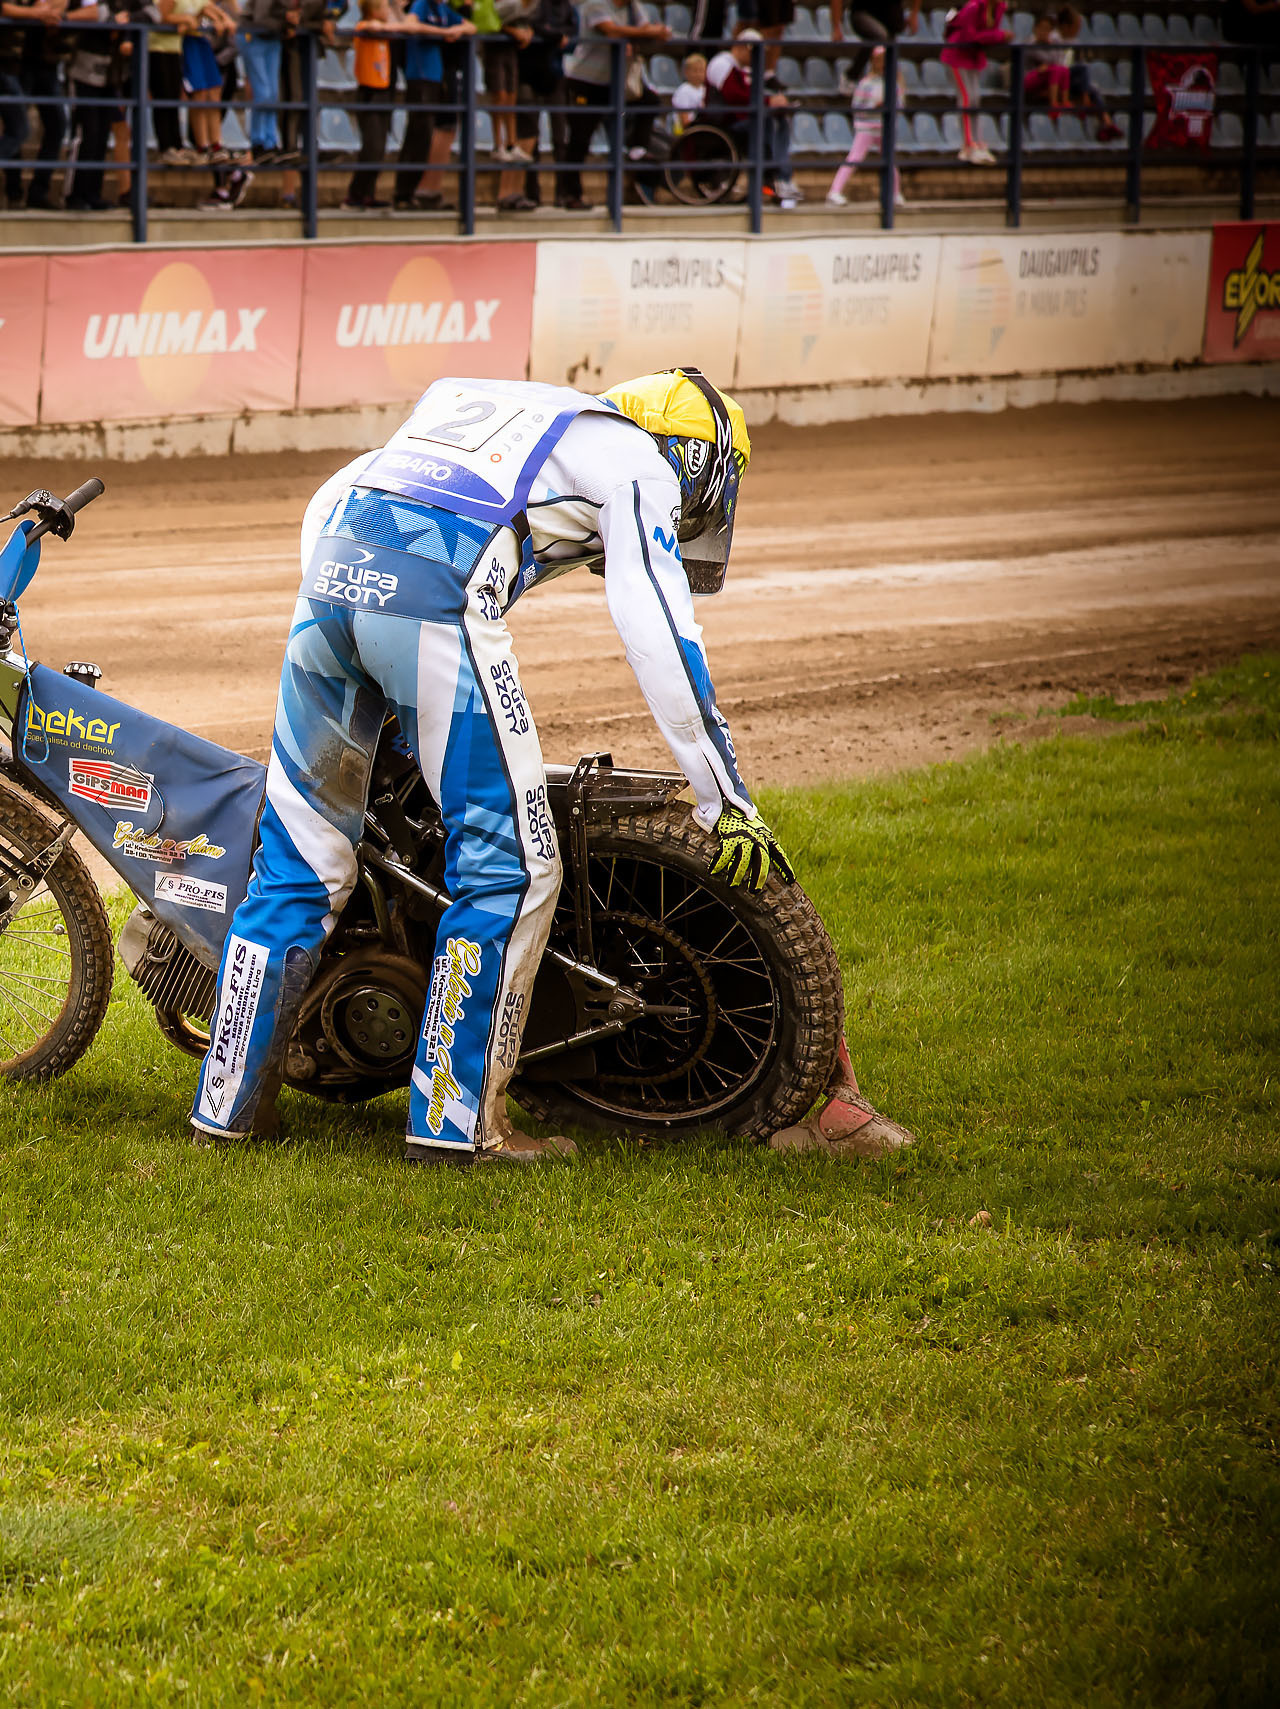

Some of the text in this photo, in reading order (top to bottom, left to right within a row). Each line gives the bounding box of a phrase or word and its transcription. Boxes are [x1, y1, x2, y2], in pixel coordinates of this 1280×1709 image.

[630, 258, 726, 289] DAUGAVPILS
[832, 253, 922, 284] DAUGAVPILS
[1019, 247, 1100, 279] DAUGAVPILS
[83, 308, 267, 358] UNIMAX
[335, 299, 501, 348] UNIMAX
[426, 400, 496, 442] 2
[27, 700, 121, 745] beker
[70, 741, 81, 749] od
[82, 743, 115, 757] dachów
[175, 834, 225, 858] Adama
[178, 882, 225, 901] PRO-FIS
[443, 939, 480, 1024] Galeria
[215, 943, 247, 1068] PRO-FIS
[431, 974, 447, 1032] Krakowska
[427, 1052, 435, 1060] A
[428, 1034, 437, 1050] 32
[428, 1047, 461, 1134] Adama
